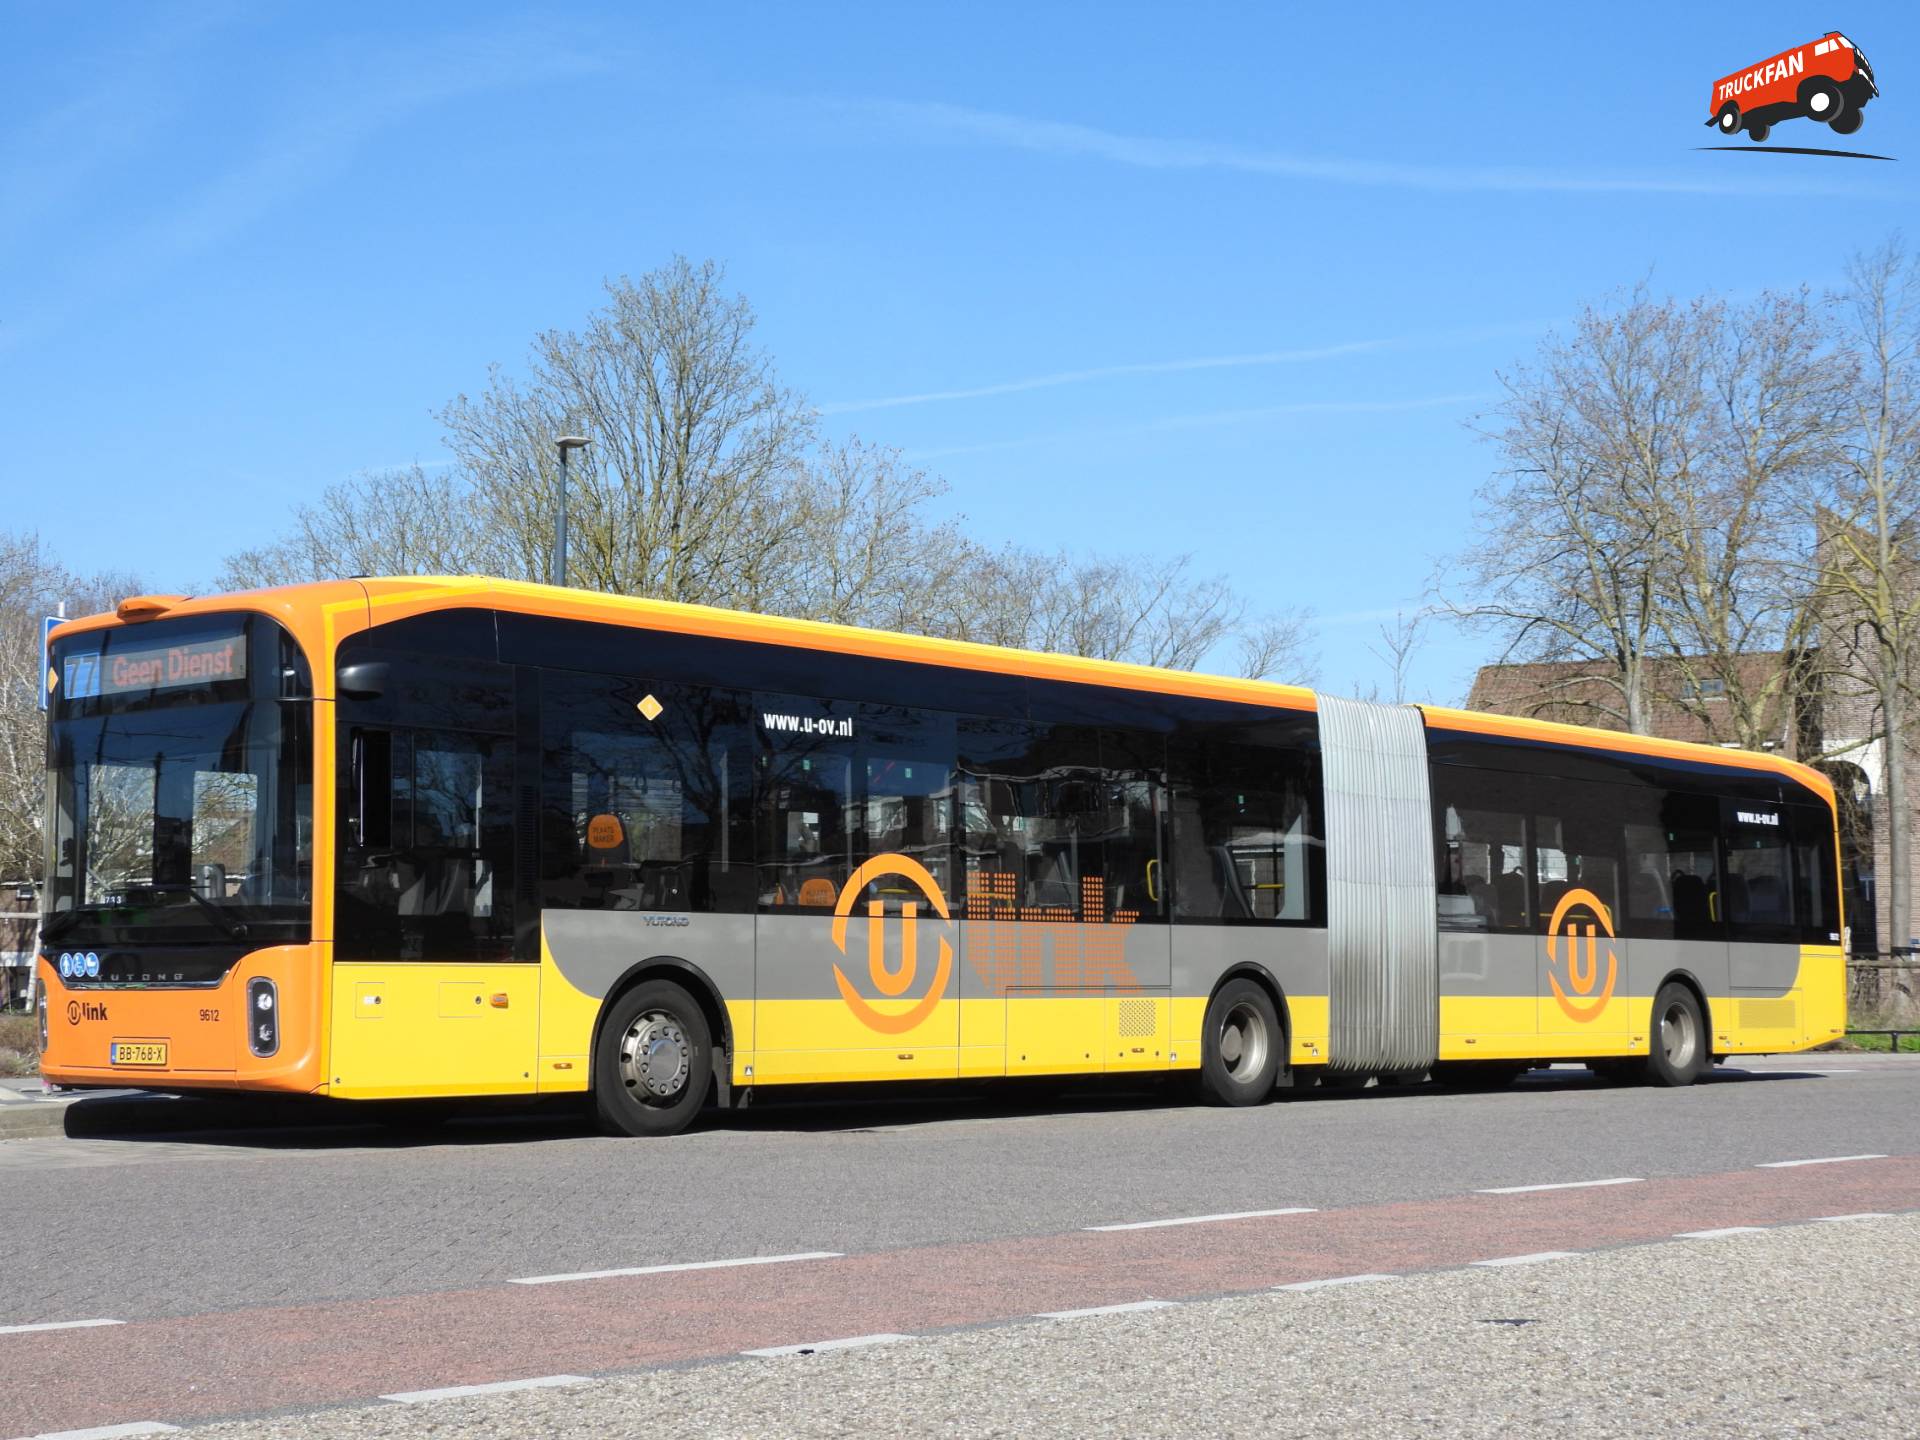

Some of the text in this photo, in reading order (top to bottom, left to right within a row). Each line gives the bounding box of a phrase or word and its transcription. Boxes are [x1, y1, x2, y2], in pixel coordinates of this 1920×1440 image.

[112, 656, 163, 687] Geen
[168, 645, 234, 681] Dienst
[763, 713, 852, 737] www.u-ov.nl
[82, 1002, 108, 1021] link
[199, 1009, 220, 1022] 9612
[119, 1046, 163, 1061] BB-768-X
